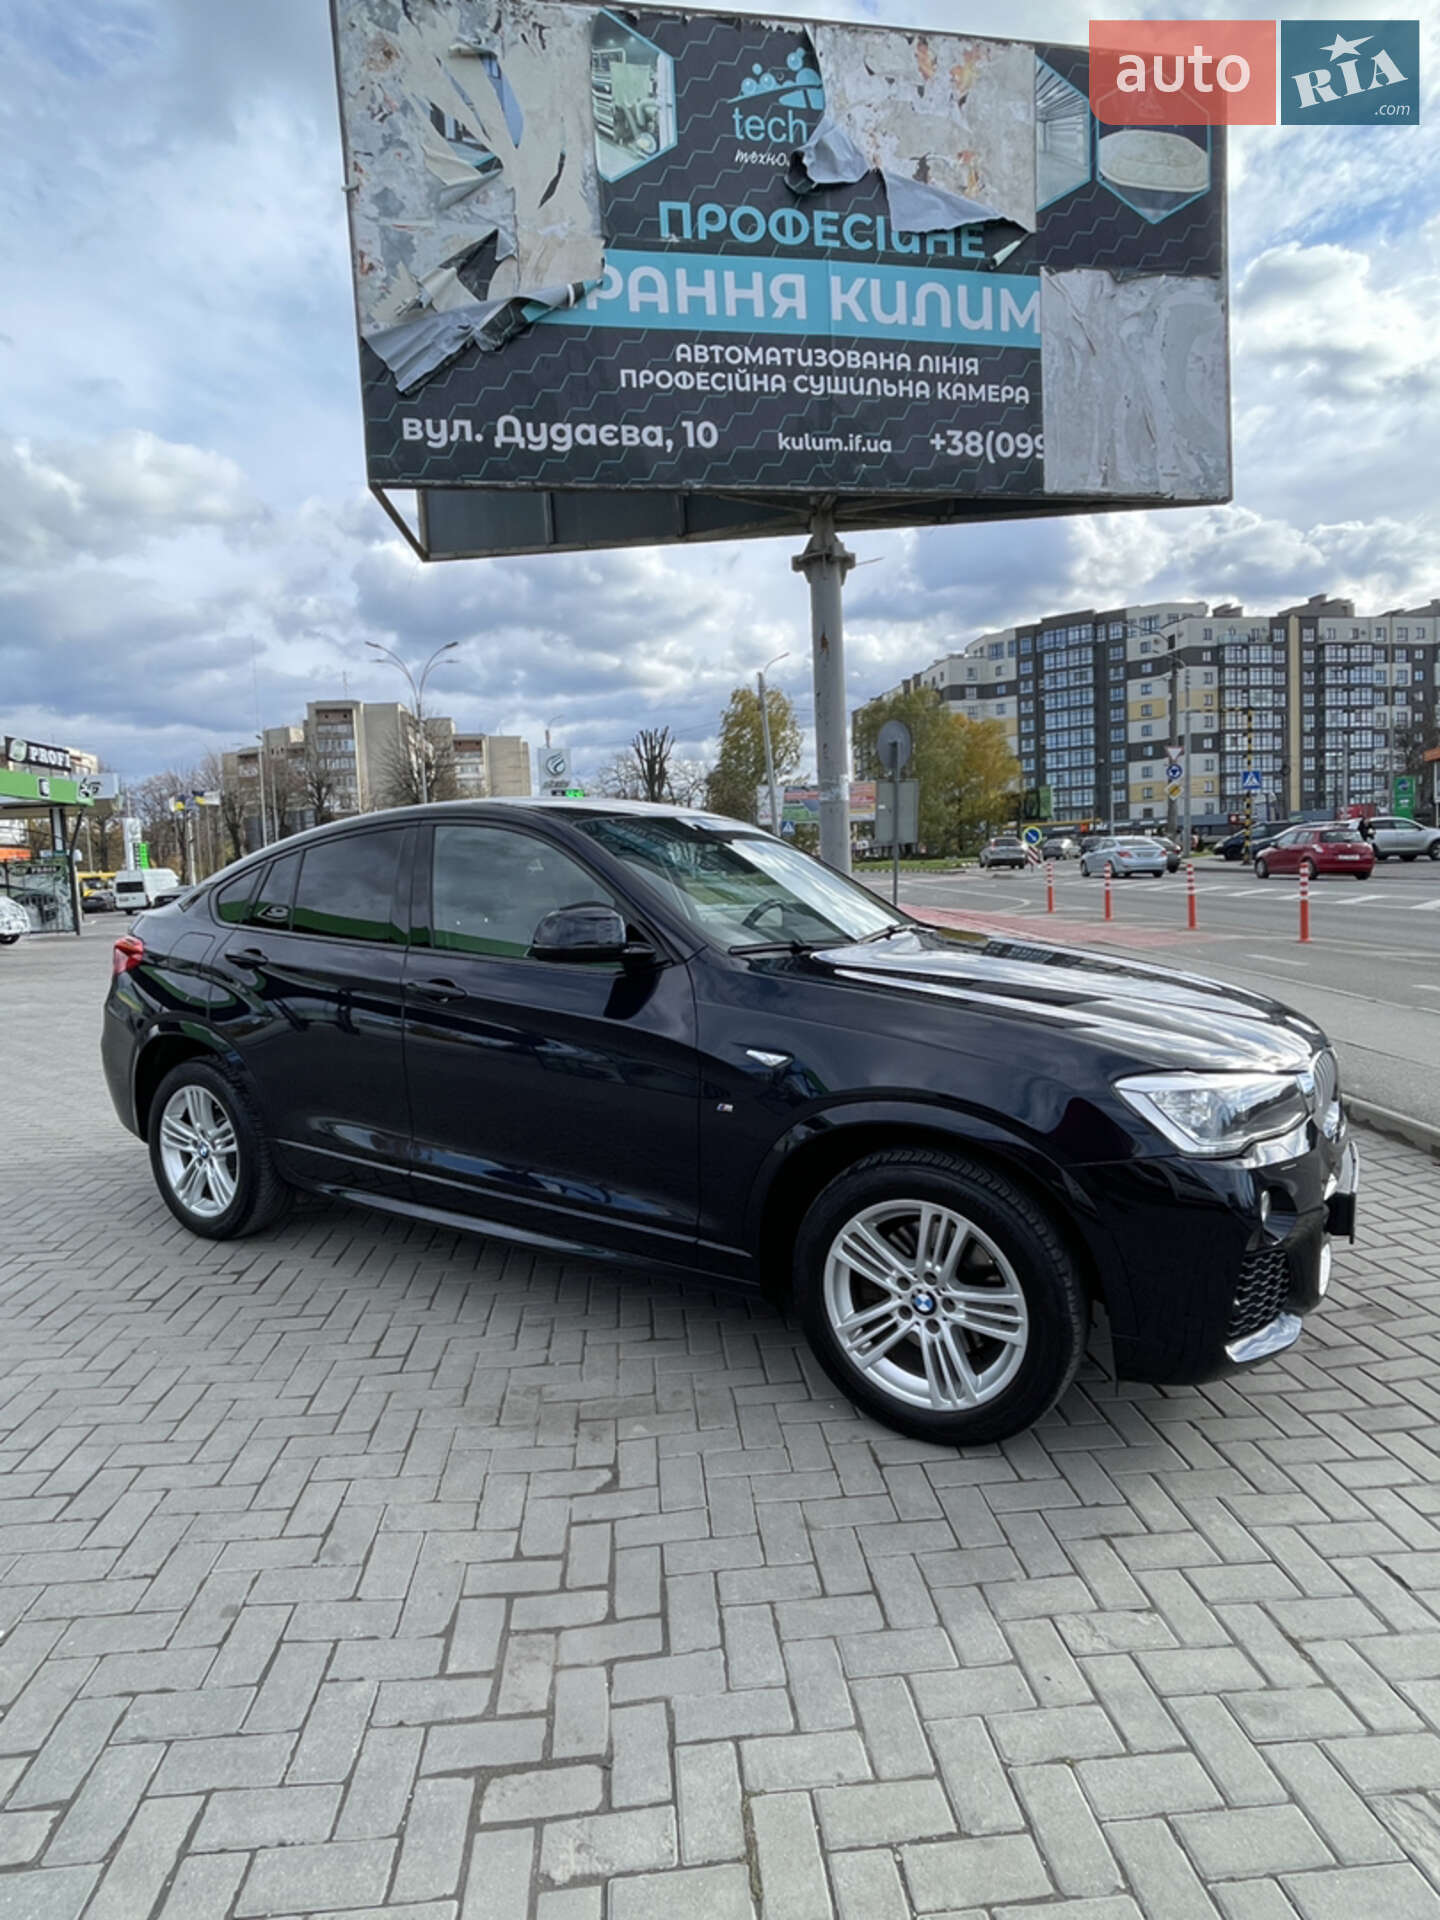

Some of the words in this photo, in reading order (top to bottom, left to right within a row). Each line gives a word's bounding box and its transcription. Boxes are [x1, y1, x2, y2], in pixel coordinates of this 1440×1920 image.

[675, 343, 911, 371] АВТОМАТИЗОВАНА
[917, 354, 979, 376] ЛІНІЯ
[620, 368, 786, 392] ПРОФЕСІЙНА
[793, 374, 930, 399] СУШИЛЬНА
[937, 381, 1030, 405] КАМЕРА
[402, 417, 483, 448] вул.
[494, 414, 674, 452] Дудаєва,
[681, 420, 719, 448] 10
[777, 432, 892, 453] kulum.if.ua
[28, 745, 71, 768] PROFI
